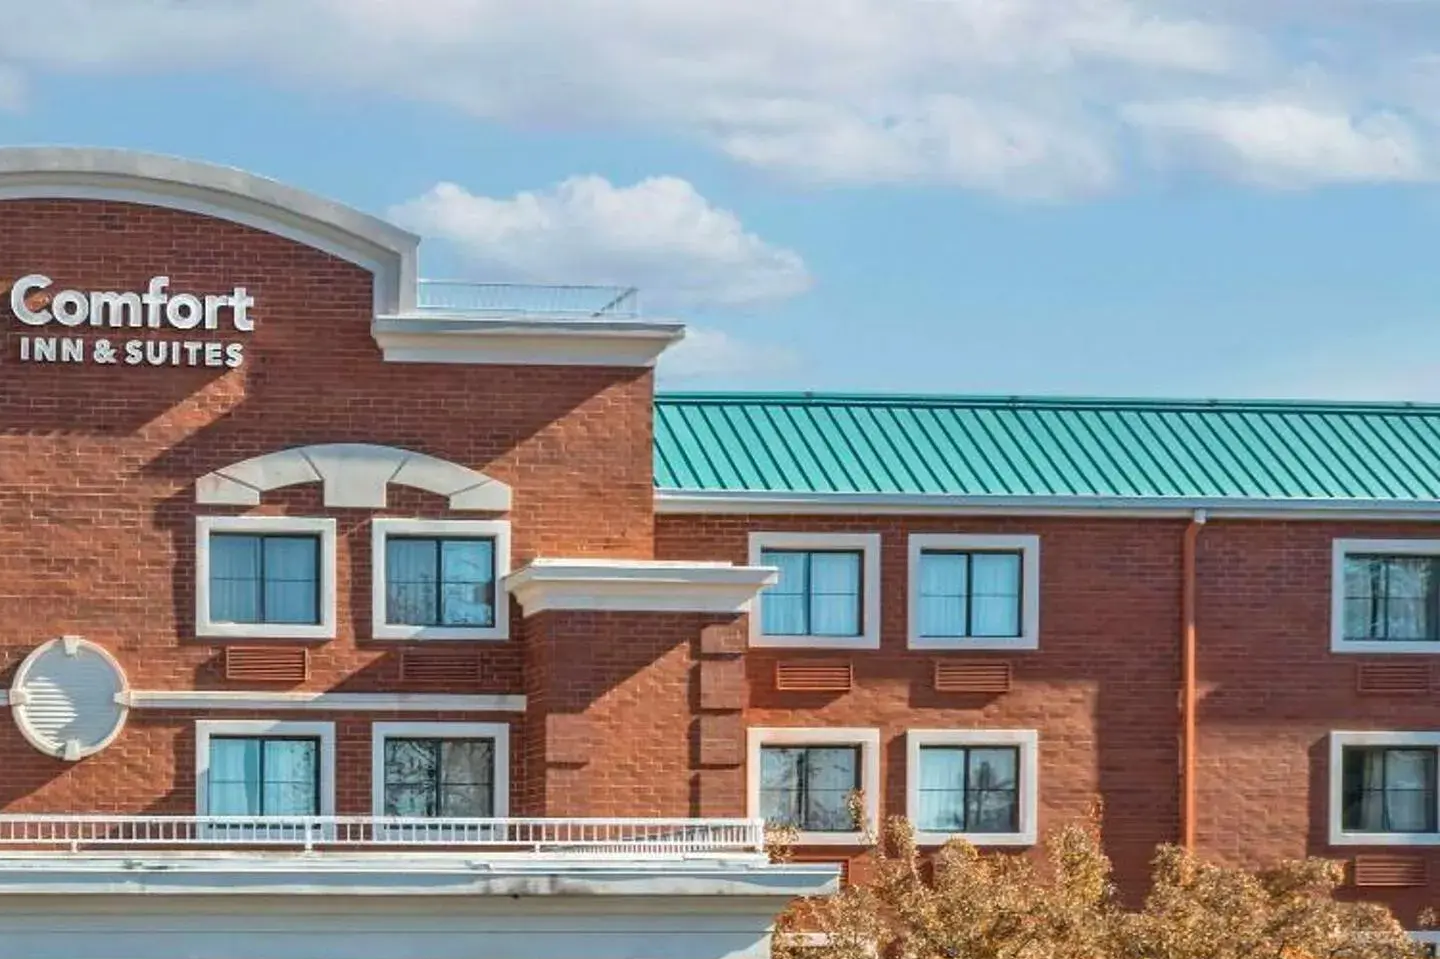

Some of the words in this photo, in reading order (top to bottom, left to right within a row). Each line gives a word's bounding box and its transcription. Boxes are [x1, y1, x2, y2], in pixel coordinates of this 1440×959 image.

[11, 273, 254, 331] Comfort
[20, 337, 84, 362] INN
[94, 339, 117, 364] &
[125, 340, 244, 368] SUITES
